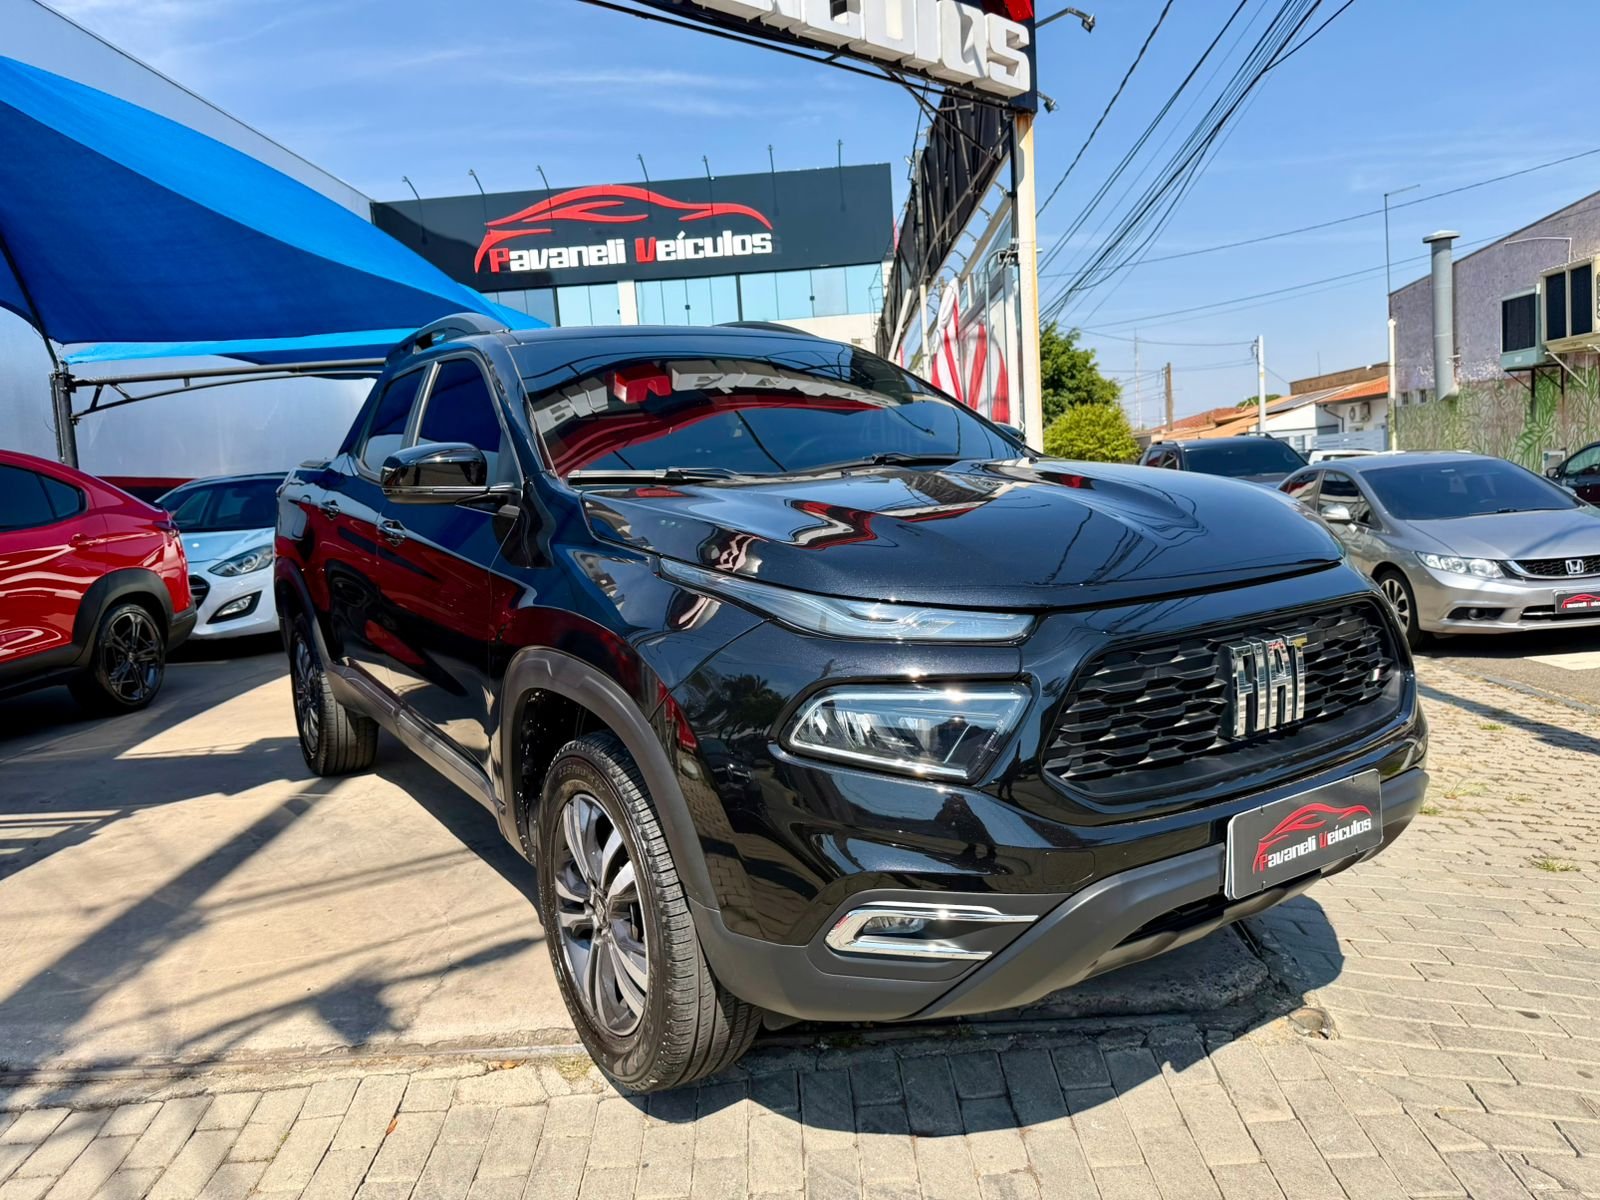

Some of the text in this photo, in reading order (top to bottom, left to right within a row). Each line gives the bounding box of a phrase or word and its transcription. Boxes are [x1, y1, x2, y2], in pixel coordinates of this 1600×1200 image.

[694, 0, 1031, 97] ulos
[489, 230, 773, 273] Pavaneli Veículos
[1230, 633, 1307, 737] FIAT
[1258, 817, 1372, 872] Pavaneli Veículos
